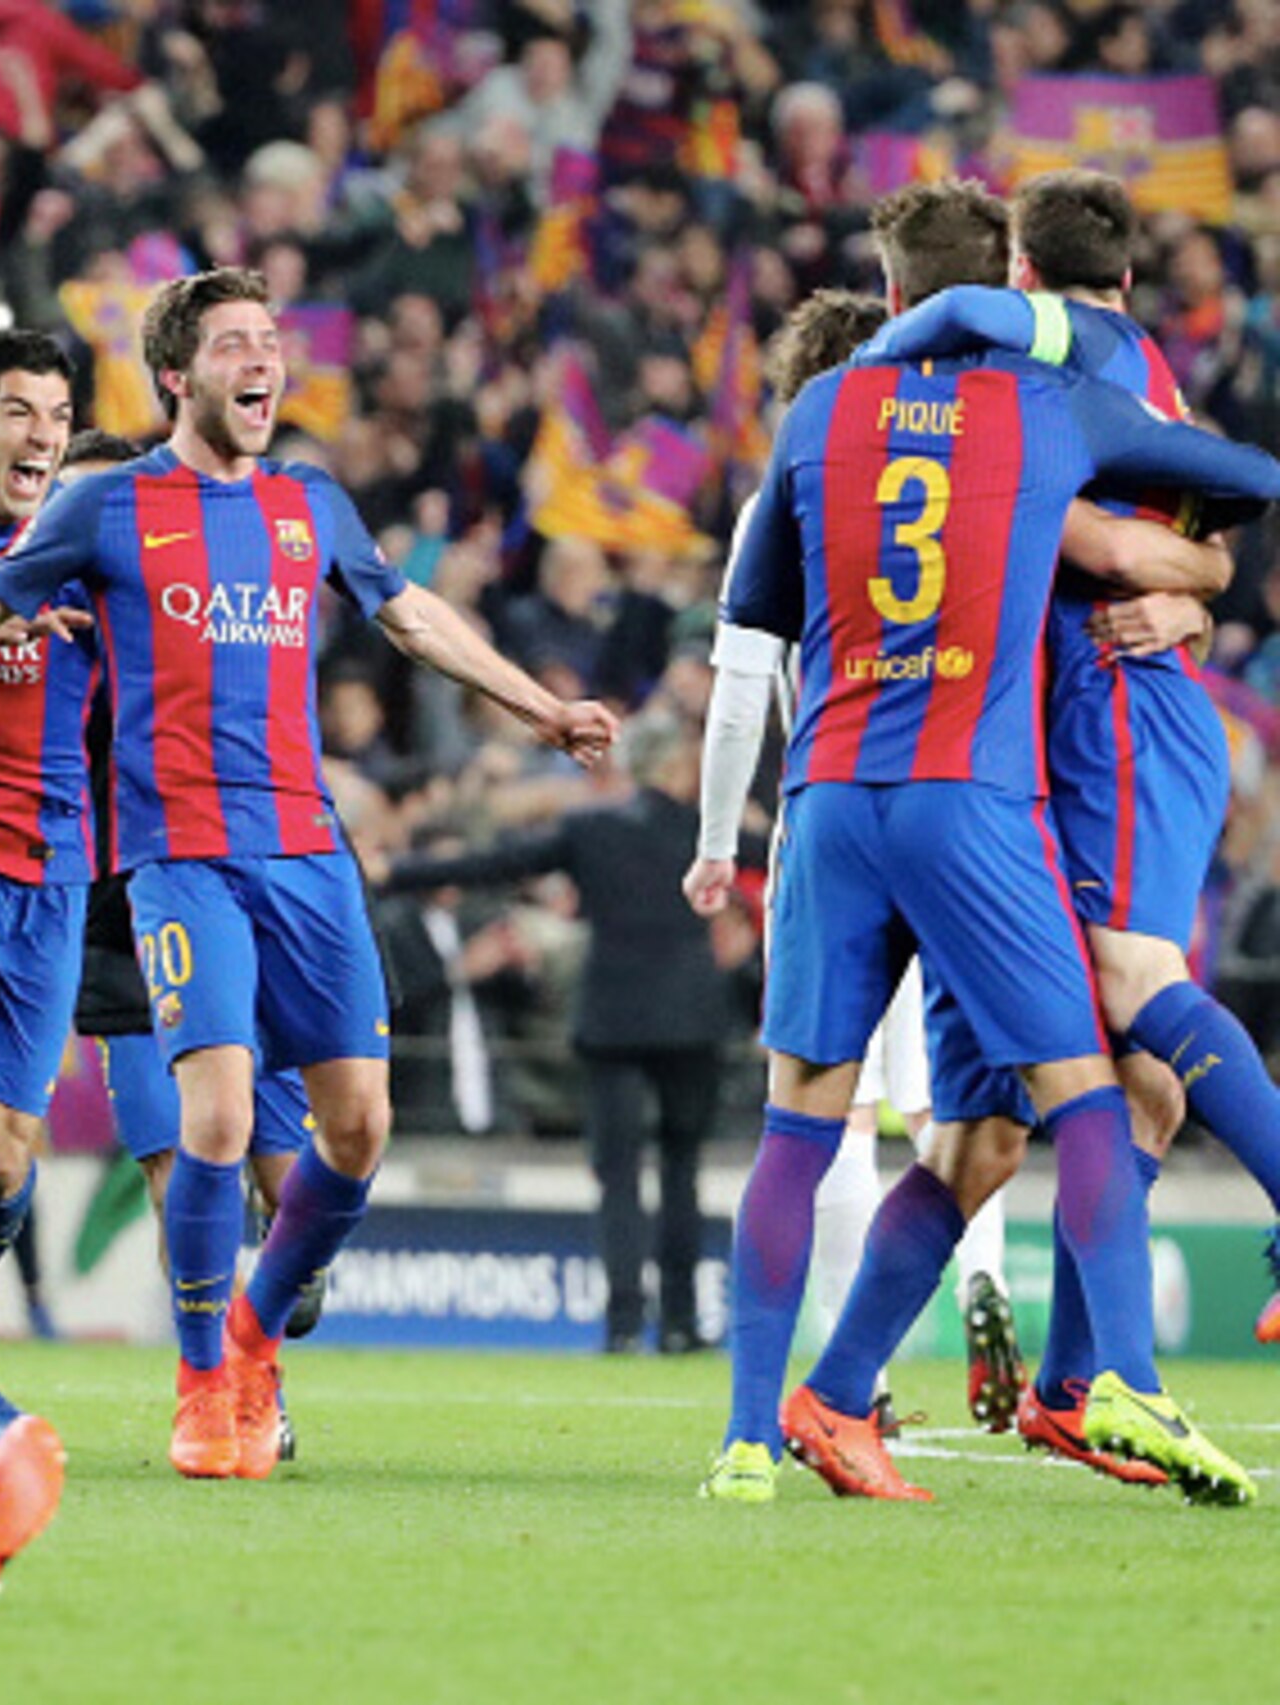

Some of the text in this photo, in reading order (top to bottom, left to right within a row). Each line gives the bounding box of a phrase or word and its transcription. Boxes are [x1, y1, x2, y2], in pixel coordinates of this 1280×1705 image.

[877, 397, 965, 436] PIQUÉ
[868, 455, 951, 625] 3
[161, 582, 308, 626] QATAR
[199, 620, 305, 648] AIRWAYS
[845, 646, 934, 680] unicef
[142, 921, 193, 998] 20
